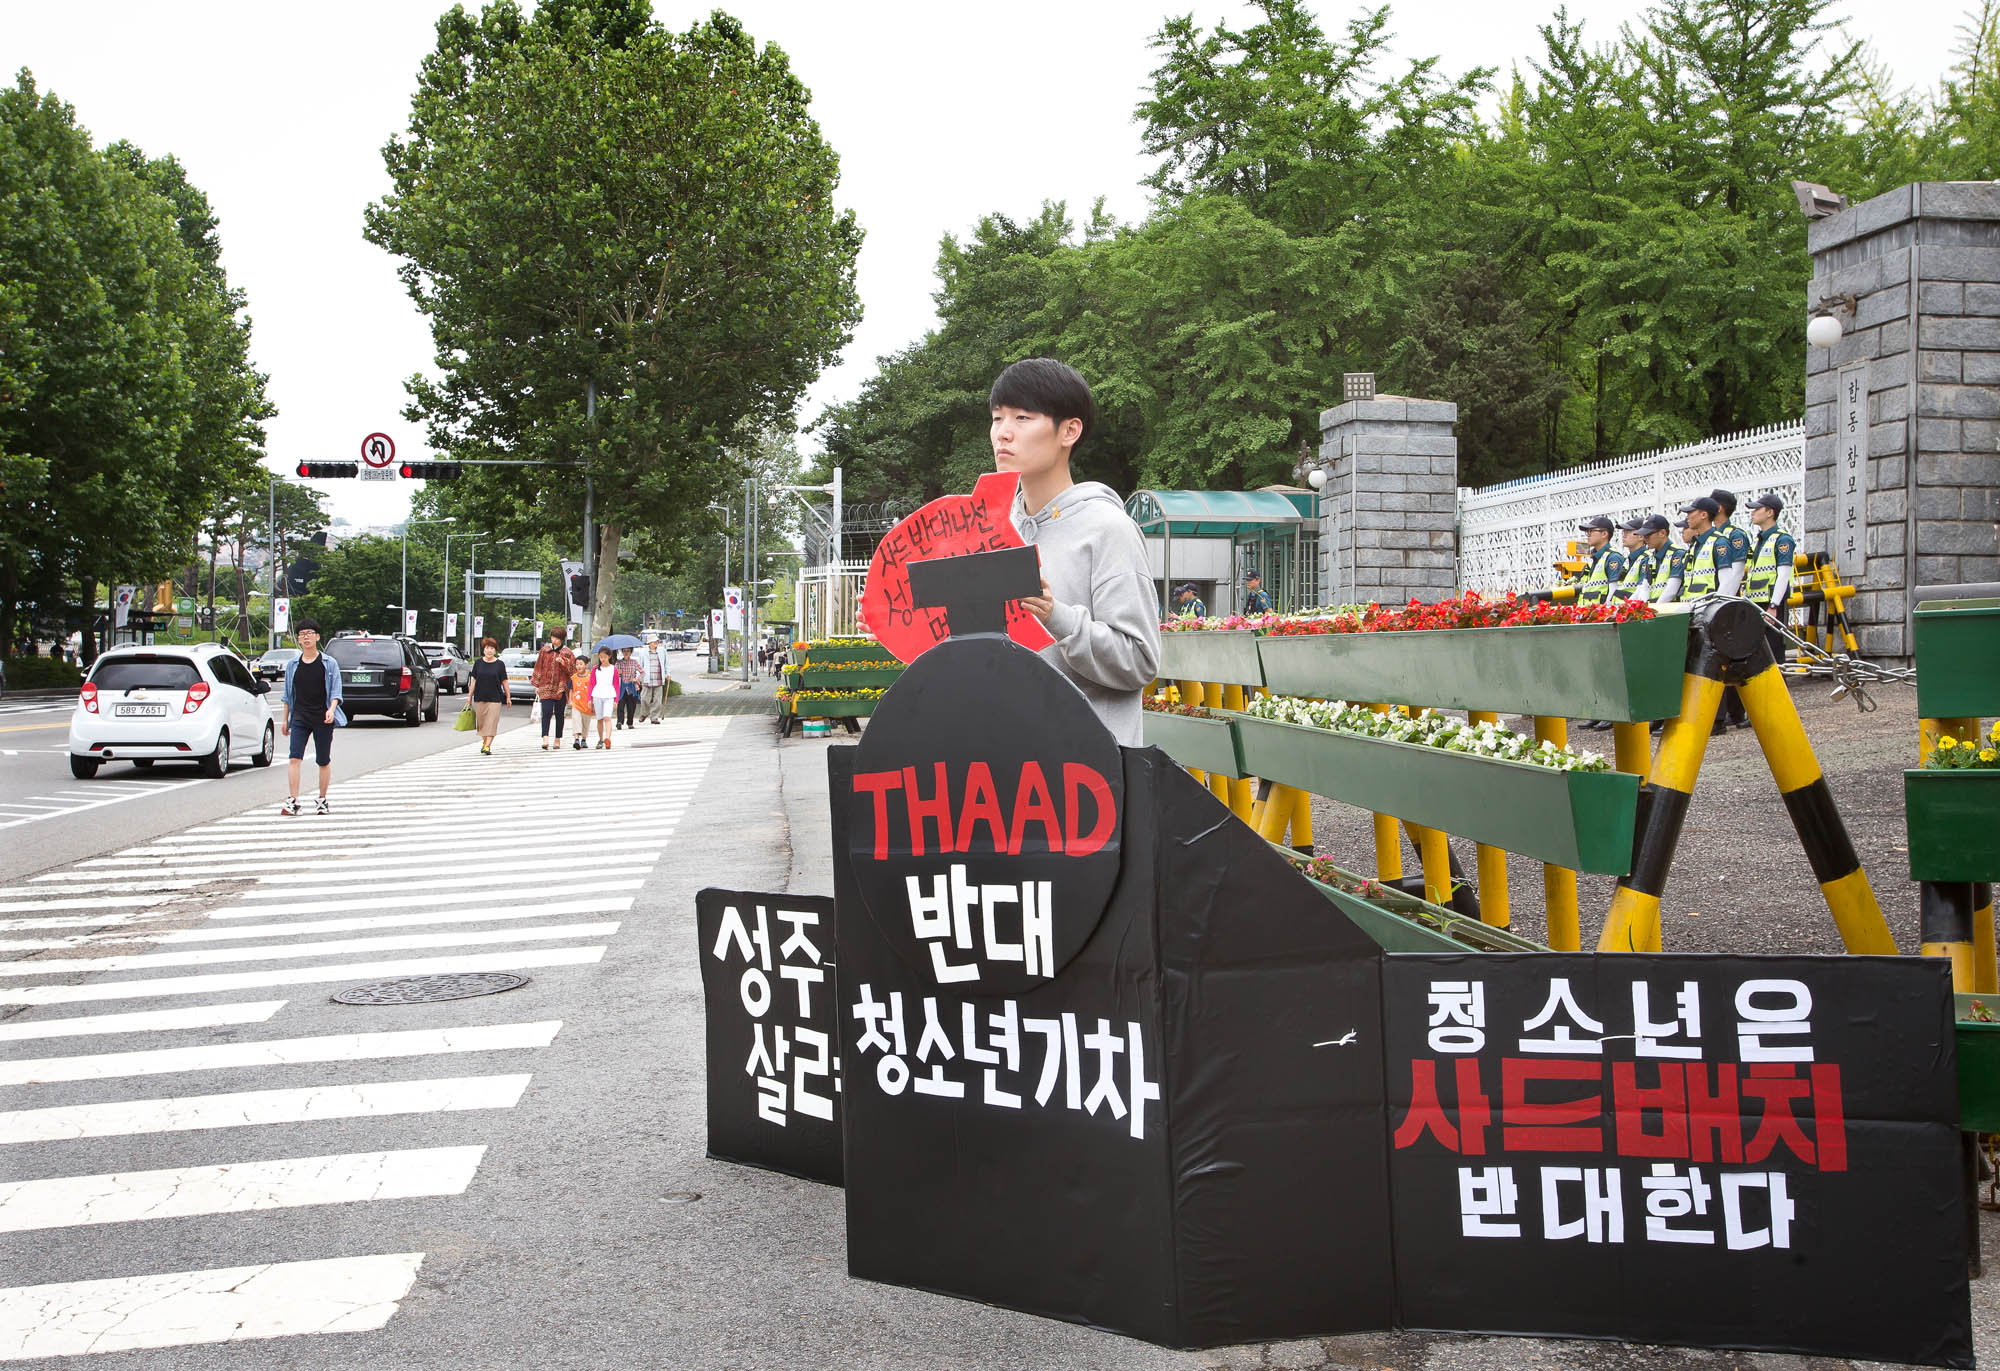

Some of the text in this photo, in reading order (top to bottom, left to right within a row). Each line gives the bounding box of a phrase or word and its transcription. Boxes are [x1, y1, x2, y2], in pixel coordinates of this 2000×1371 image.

[140, 706, 161, 714] 7651
[853, 760, 1117, 861] THAAD
[712, 905, 824, 1018] 성주
[905, 864, 1055, 984] 반대
[852, 983, 1161, 1140] 청소년기차
[1426, 978, 1815, 1062] 청소년은
[1394, 1057, 1848, 1172] 사드배치
[1457, 1163, 1795, 1251] 반대한다
